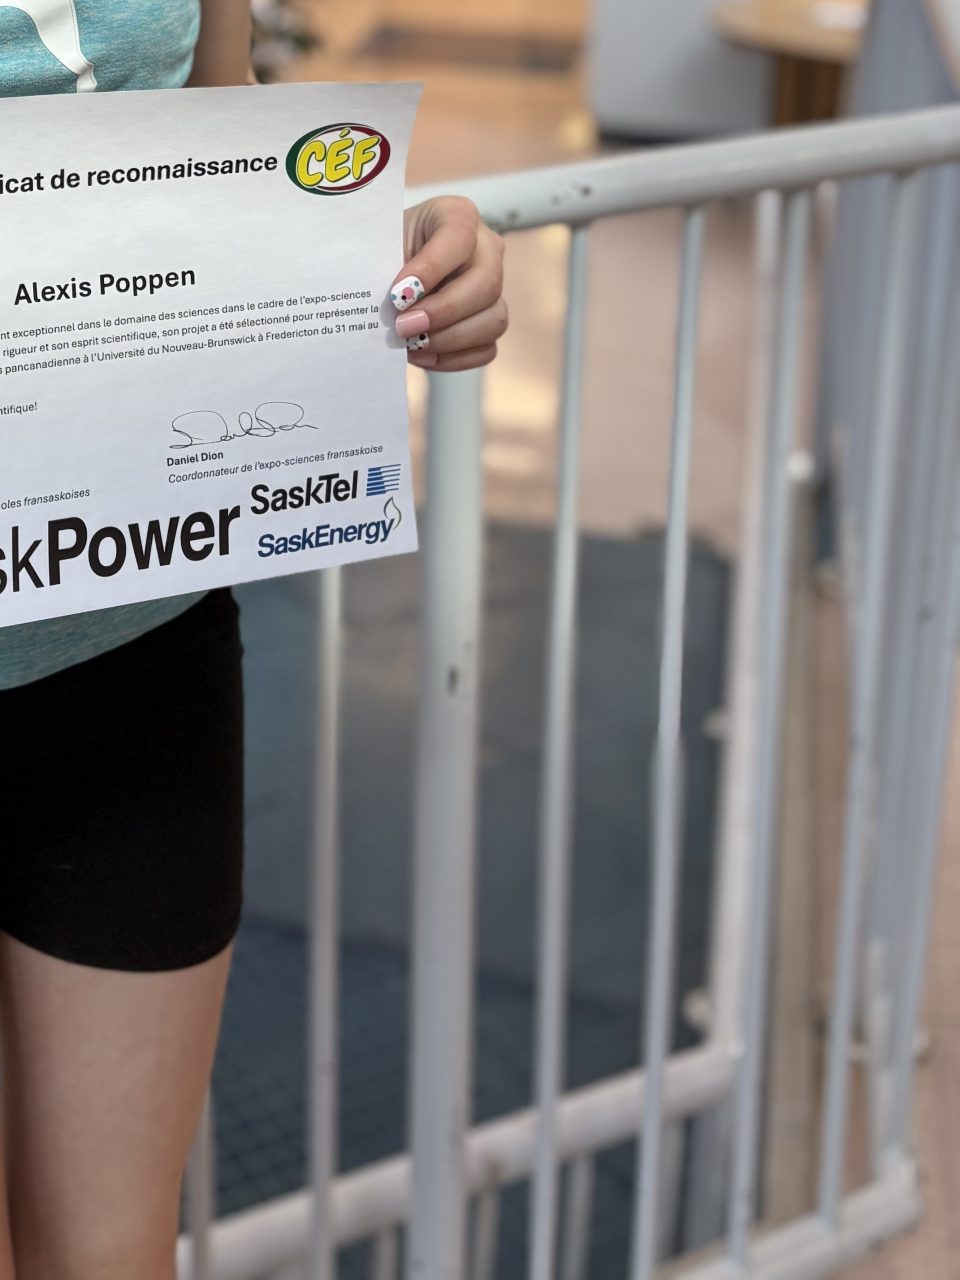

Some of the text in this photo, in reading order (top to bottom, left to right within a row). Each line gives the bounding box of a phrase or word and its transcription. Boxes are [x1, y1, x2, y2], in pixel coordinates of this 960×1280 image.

[50, 168, 80, 190] de
[87, 153, 278, 186] reconnaissance
[296, 126, 383, 187] CÉF
[14, 269, 196, 305] Alexis Poppen
[3, 346, 37, 357] rigueur
[39, 343, 49, 352] et
[51, 341, 69, 351] son
[71, 336, 99, 350] esprit
[162, 328, 180, 337] son
[181, 322, 209, 336] projet
[211, 323, 217, 331] a
[219, 319, 234, 330] été
[236, 314, 290, 328] sélectionné
[292, 312, 314, 323] pour
[315, 307, 368, 320] représenter
[370, 305, 379, 313] la
[12, 322, 75, 339] exceptionnel
[77, 320, 101, 330] dans
[103, 318, 112, 327] le
[114, 314, 156, 326] domaine
[158, 311, 176, 321] des
[178, 306, 220, 319] sciences
[222, 303, 245, 314] dans
[246, 301, 256, 311] le
[257, 298, 284, 310] cadre
[286, 297, 298, 306] de
[5, 355, 81, 375] pancanadienne
[82, 354, 89, 363] à
[147, 345, 160, 355] du
[162, 333, 256, 354] Nouveau-Brunswick
[257, 332, 264, 342] à
[266, 327, 319, 341] Fredericton
[321, 324, 333, 335] du
[335, 324, 346, 333] 31
[348, 322, 366, 332] mai
[367, 321, 379, 330] au
[166, 450, 224, 467] Daniel Dion
[168, 465, 239, 484] Coordonnateur
[240, 463, 253, 472] de
[326, 444, 384, 461] fransaskoise
[23, 487, 91, 507] fransaskoises
[250, 470, 359, 515] SaskTel
[257, 518, 396, 558] SaskEnergy
